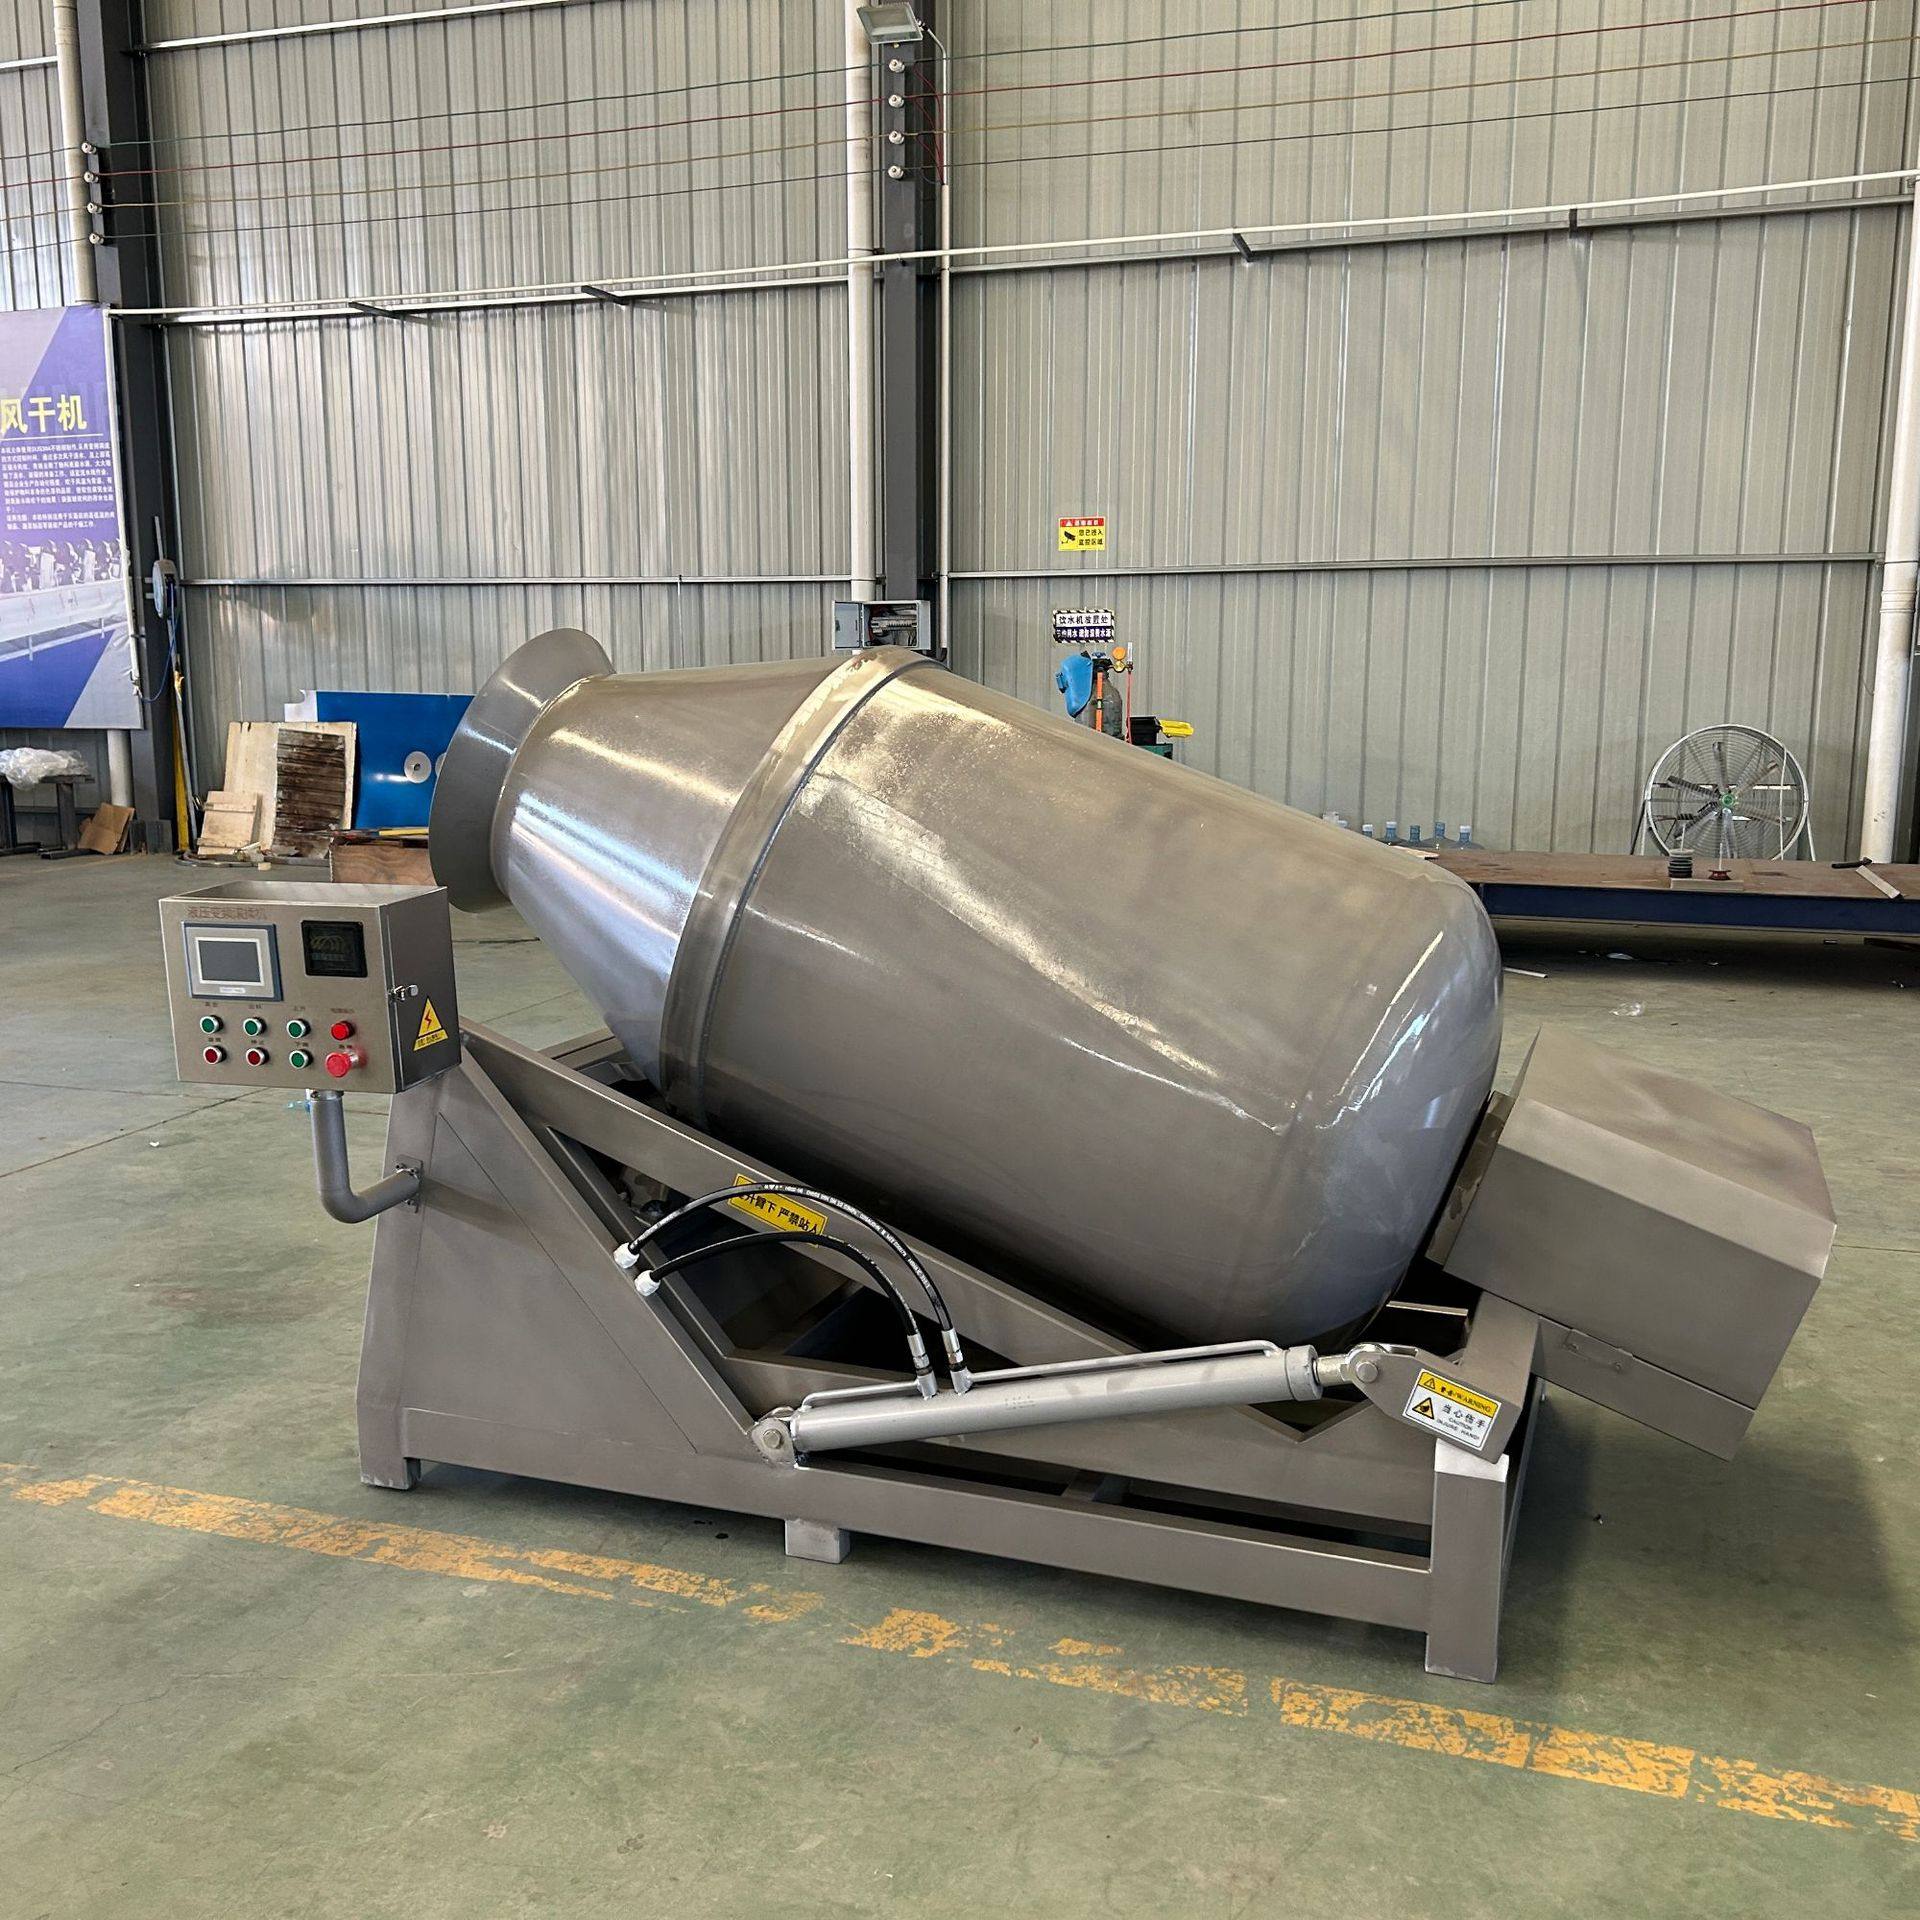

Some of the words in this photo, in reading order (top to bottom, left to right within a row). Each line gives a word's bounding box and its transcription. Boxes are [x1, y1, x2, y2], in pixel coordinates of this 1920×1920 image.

[0, 394, 88, 434] 风干机
[739, 1193, 777, 1213] 升臂下
[777, 1207, 817, 1233] 严禁站人
